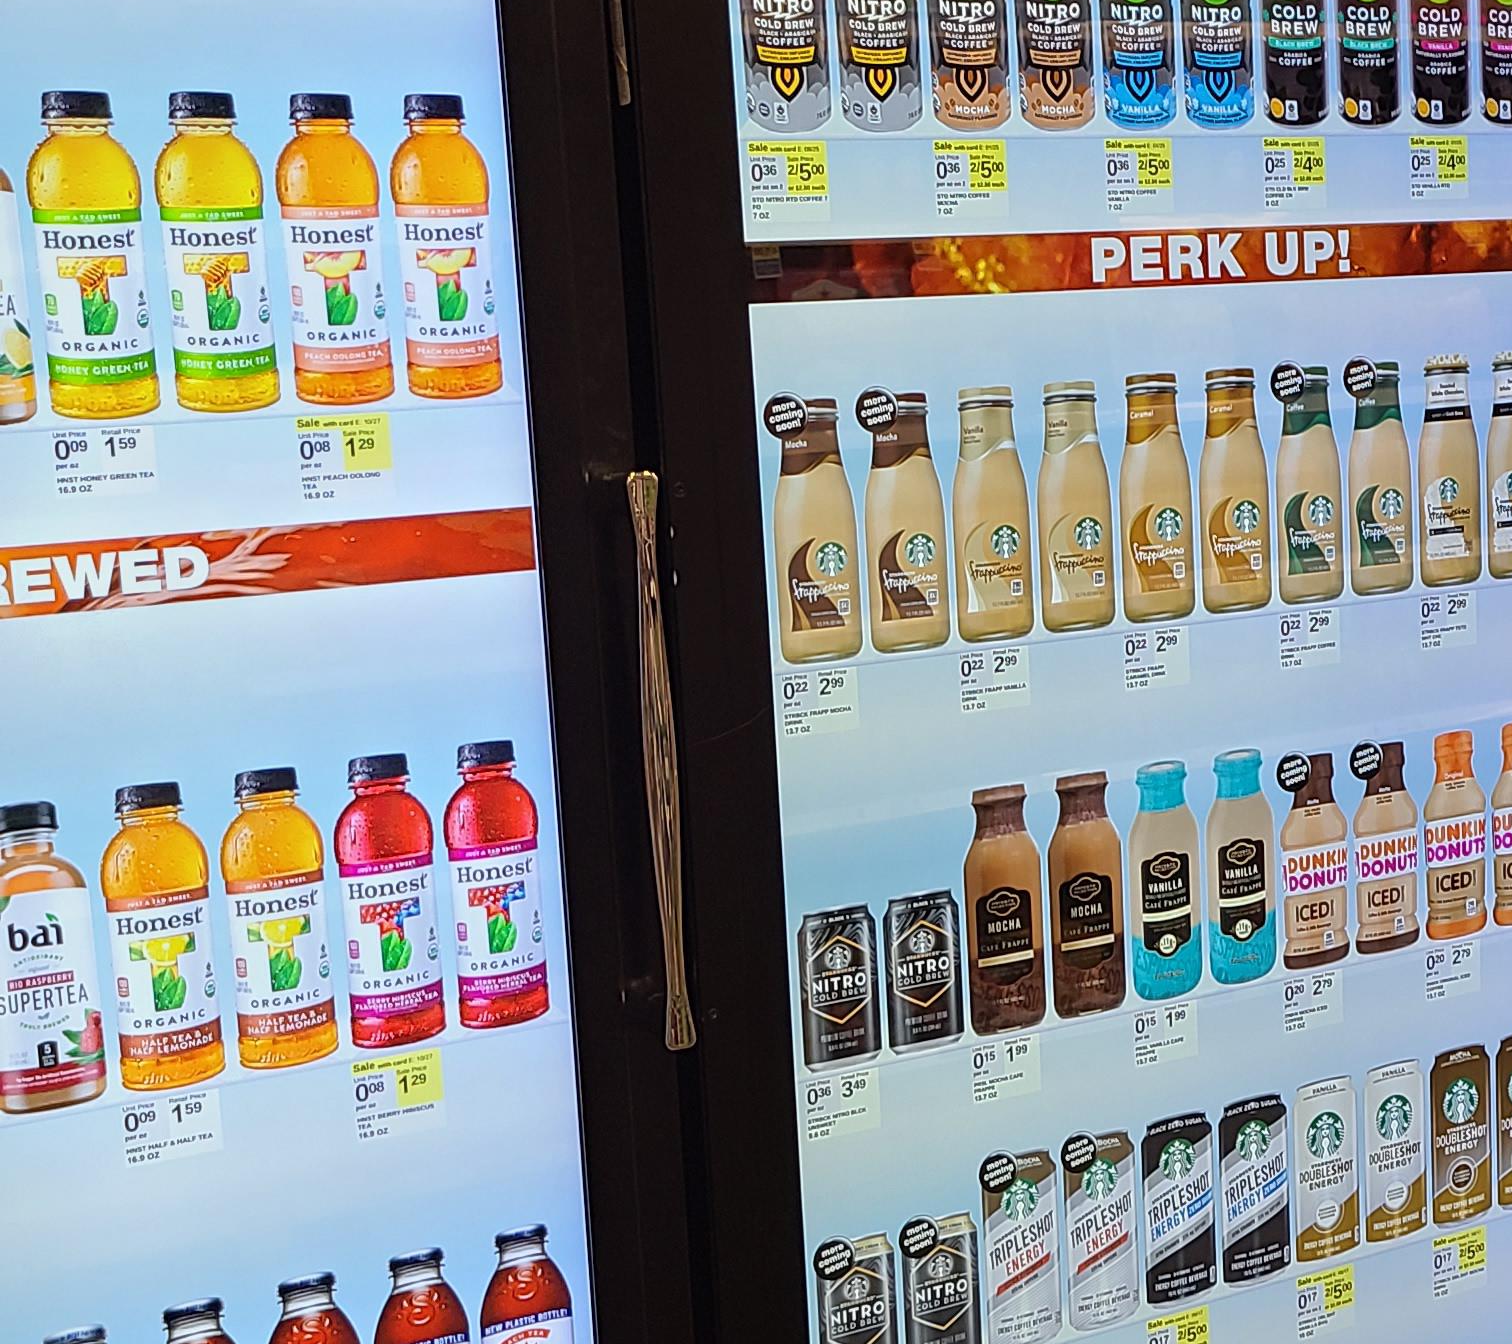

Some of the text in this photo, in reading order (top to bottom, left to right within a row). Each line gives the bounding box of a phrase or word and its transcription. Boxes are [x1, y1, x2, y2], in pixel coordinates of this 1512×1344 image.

[1272, 5, 1316, 20] COLD
[1346, 6, 1390, 22] COLD
[1419, 7, 1461, 22] COLD
[754, 17, 814, 29] COLD BREW
[1270, 19, 1318, 36] BREW
[1345, 20, 1392, 37] BREW
[1418, 22, 1462, 38] BREW
[766, 36, 805, 47] COFFEE
[955, 104, 990, 115] MOCHA
[749, 143, 768, 153] Sale
[43, 227, 135, 251] Honest
[170, 226, 257, 248] Honest
[290, 224, 374, 245] Honest
[403, 221, 484, 243] Honest
[1091, 229, 1351, 283] PERK UP!
[306, 329, 376, 341] ORGANIC
[419, 323, 486, 336] ORGANIC
[61, 338, 139, 352] ORGANIC
[187, 333, 260, 347] ORGANIC
[86, 361, 131, 376] GREEN
[133, 359, 149, 373] TEA
[772, 401, 796, 413] more
[1129, 409, 1154, 419] Caramel
[1209, 404, 1233, 414] Caramel
[297, 418, 320, 429] Sale
[769, 409, 803, 424] coming
[775, 419, 802, 432] soon!
[963, 425, 984, 435] Vanilla
[785, 440, 807, 449] Mocha
[108, 472, 137, 480] GREEN
[139, 470, 154, 478] TEA
[57, 483, 93, 494] 16.9 OZ
[303, 490, 335, 500] 16.9 OZ
[0, 546, 210, 606] EWED
[1427, 835, 1485, 862] DONUTS
[456, 858, 534, 885] Honest
[1224, 864, 1259, 879] VANILLA
[348, 873, 429, 901] Honest
[1148, 878, 1183, 893] VANILLA
[1435, 872, 1471, 893] ICED
[235, 889, 318, 918] Honest
[1070, 903, 1103, 918] MOCHA
[1295, 899, 1329, 922] ICED
[115, 906, 203, 936] Honest
[988, 918, 1022, 933] MOCHA
[8, 911, 64, 953] bai
[470, 952, 534, 971] ORGANIC
[897, 957, 949, 978] NITRO
[363, 971, 429, 990] ORGANIC
[813, 973, 867, 994] NITRO
[251, 989, 320, 1009] ORGANIC
[813, 985, 867, 1002] COLD BREW
[133, 1009, 206, 1029] ORGANIC
[141, 1037, 169, 1049] HALF
[158, 1033, 214, 1053] LEMONADE
[1436, 1124, 1487, 1148] DOUBLESHOT
[1445, 1139, 1479, 1155] ENERGY
[1299, 1159, 1354, 1185] DOUBLESHOT
[1070, 1190, 1133, 1249] TRIPLESHOT
[989, 1209, 1055, 1270] TRIPLESHOT
[1085, 1221, 1124, 1253] ENERGY
[1006, 1240, 1045, 1276] ENERGY
